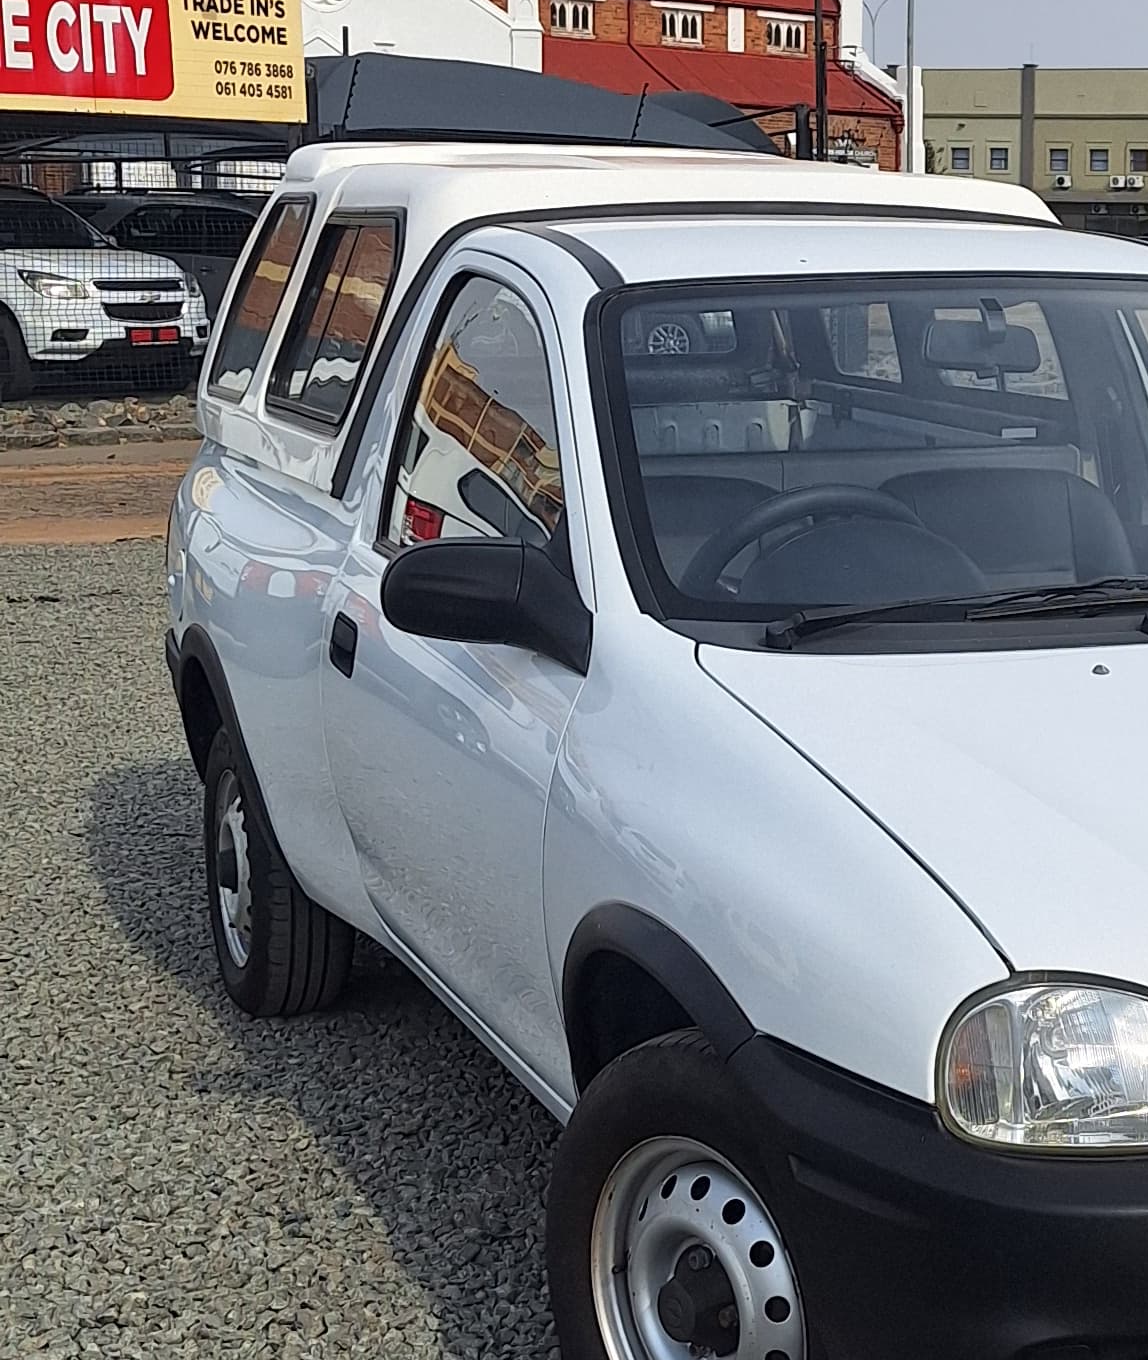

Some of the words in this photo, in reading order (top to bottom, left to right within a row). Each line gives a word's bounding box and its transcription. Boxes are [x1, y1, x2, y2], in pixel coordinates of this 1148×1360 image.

[46, 0, 153, 76] CITY
[190, 19, 288, 46] WELCOME
[214, 60, 237, 76] 076
[240, 61, 262, 77] 786
[265, 62, 294, 79] 3868
[215, 81, 237, 97] 061
[239, 82, 263, 98] 405
[266, 83, 293, 100] 4581
